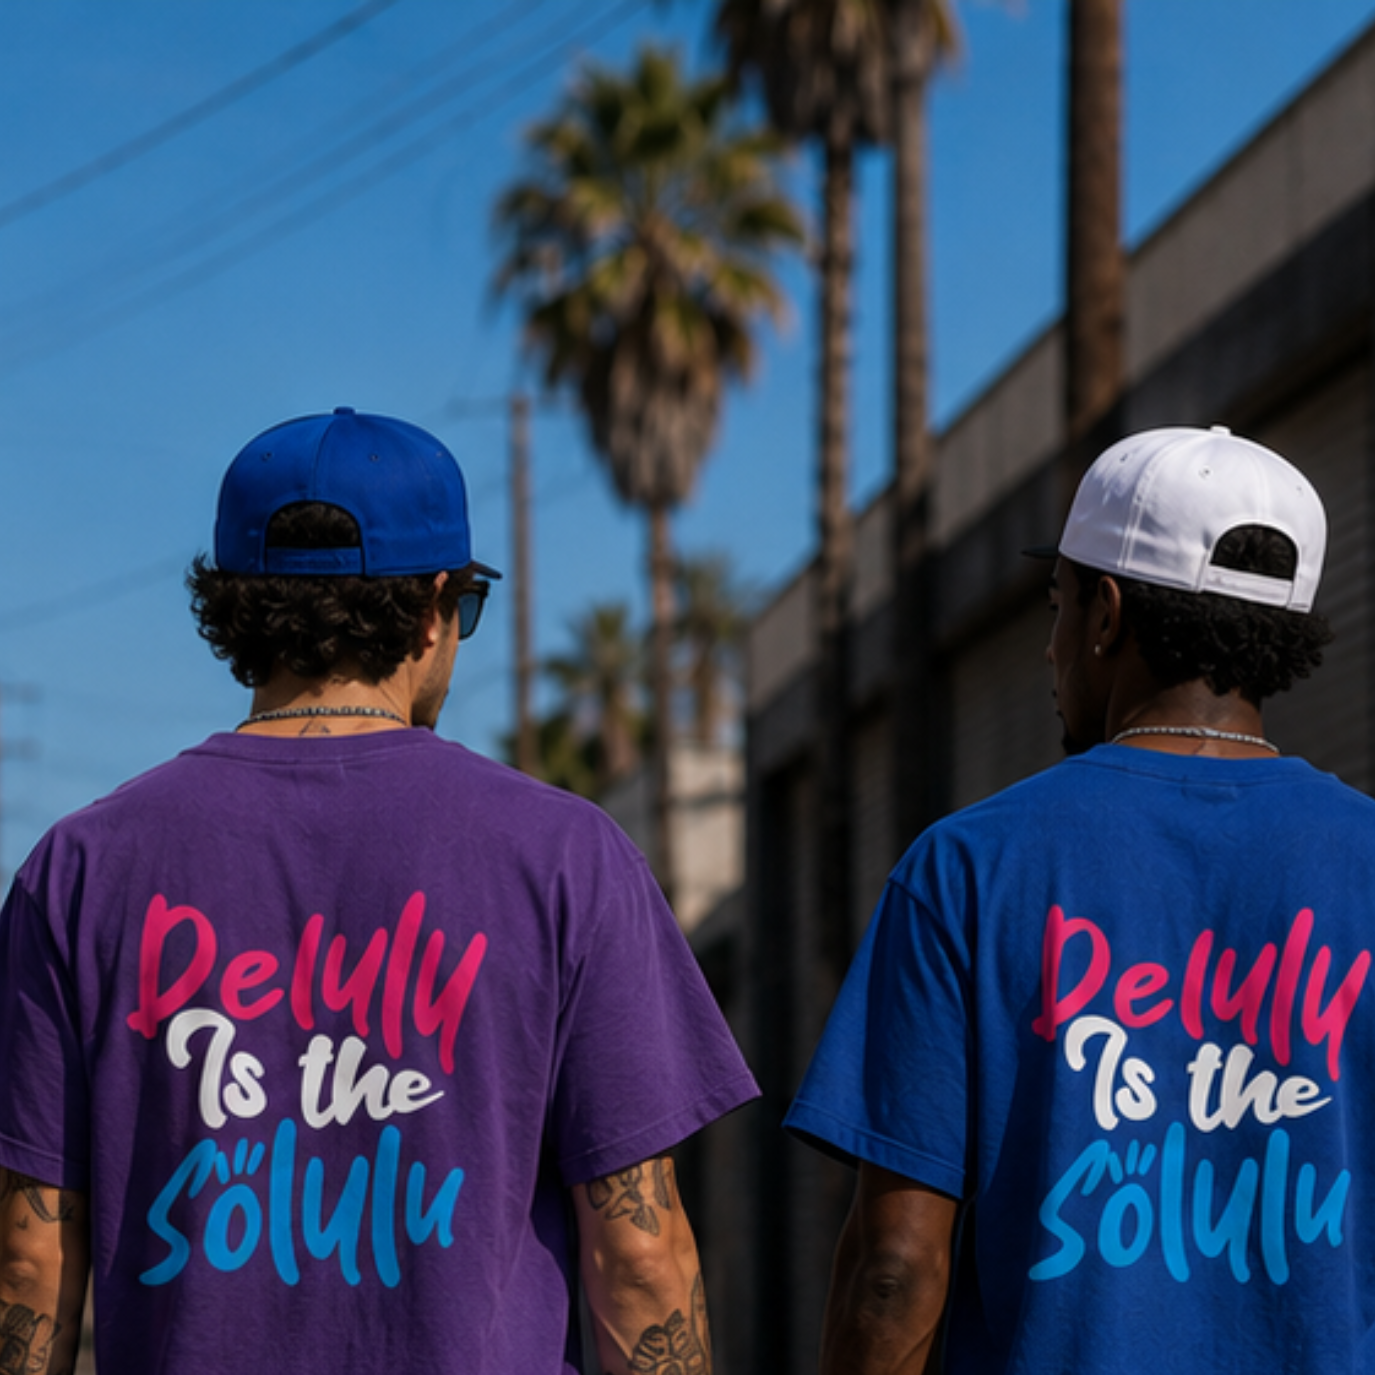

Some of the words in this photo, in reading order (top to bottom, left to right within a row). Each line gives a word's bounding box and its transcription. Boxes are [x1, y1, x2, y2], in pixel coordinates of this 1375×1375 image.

[166, 1008, 268, 1130] Is
[297, 1033, 445, 1129] the
[1063, 1014, 1158, 1131] Is
[1186, 1042, 1332, 1132] the
